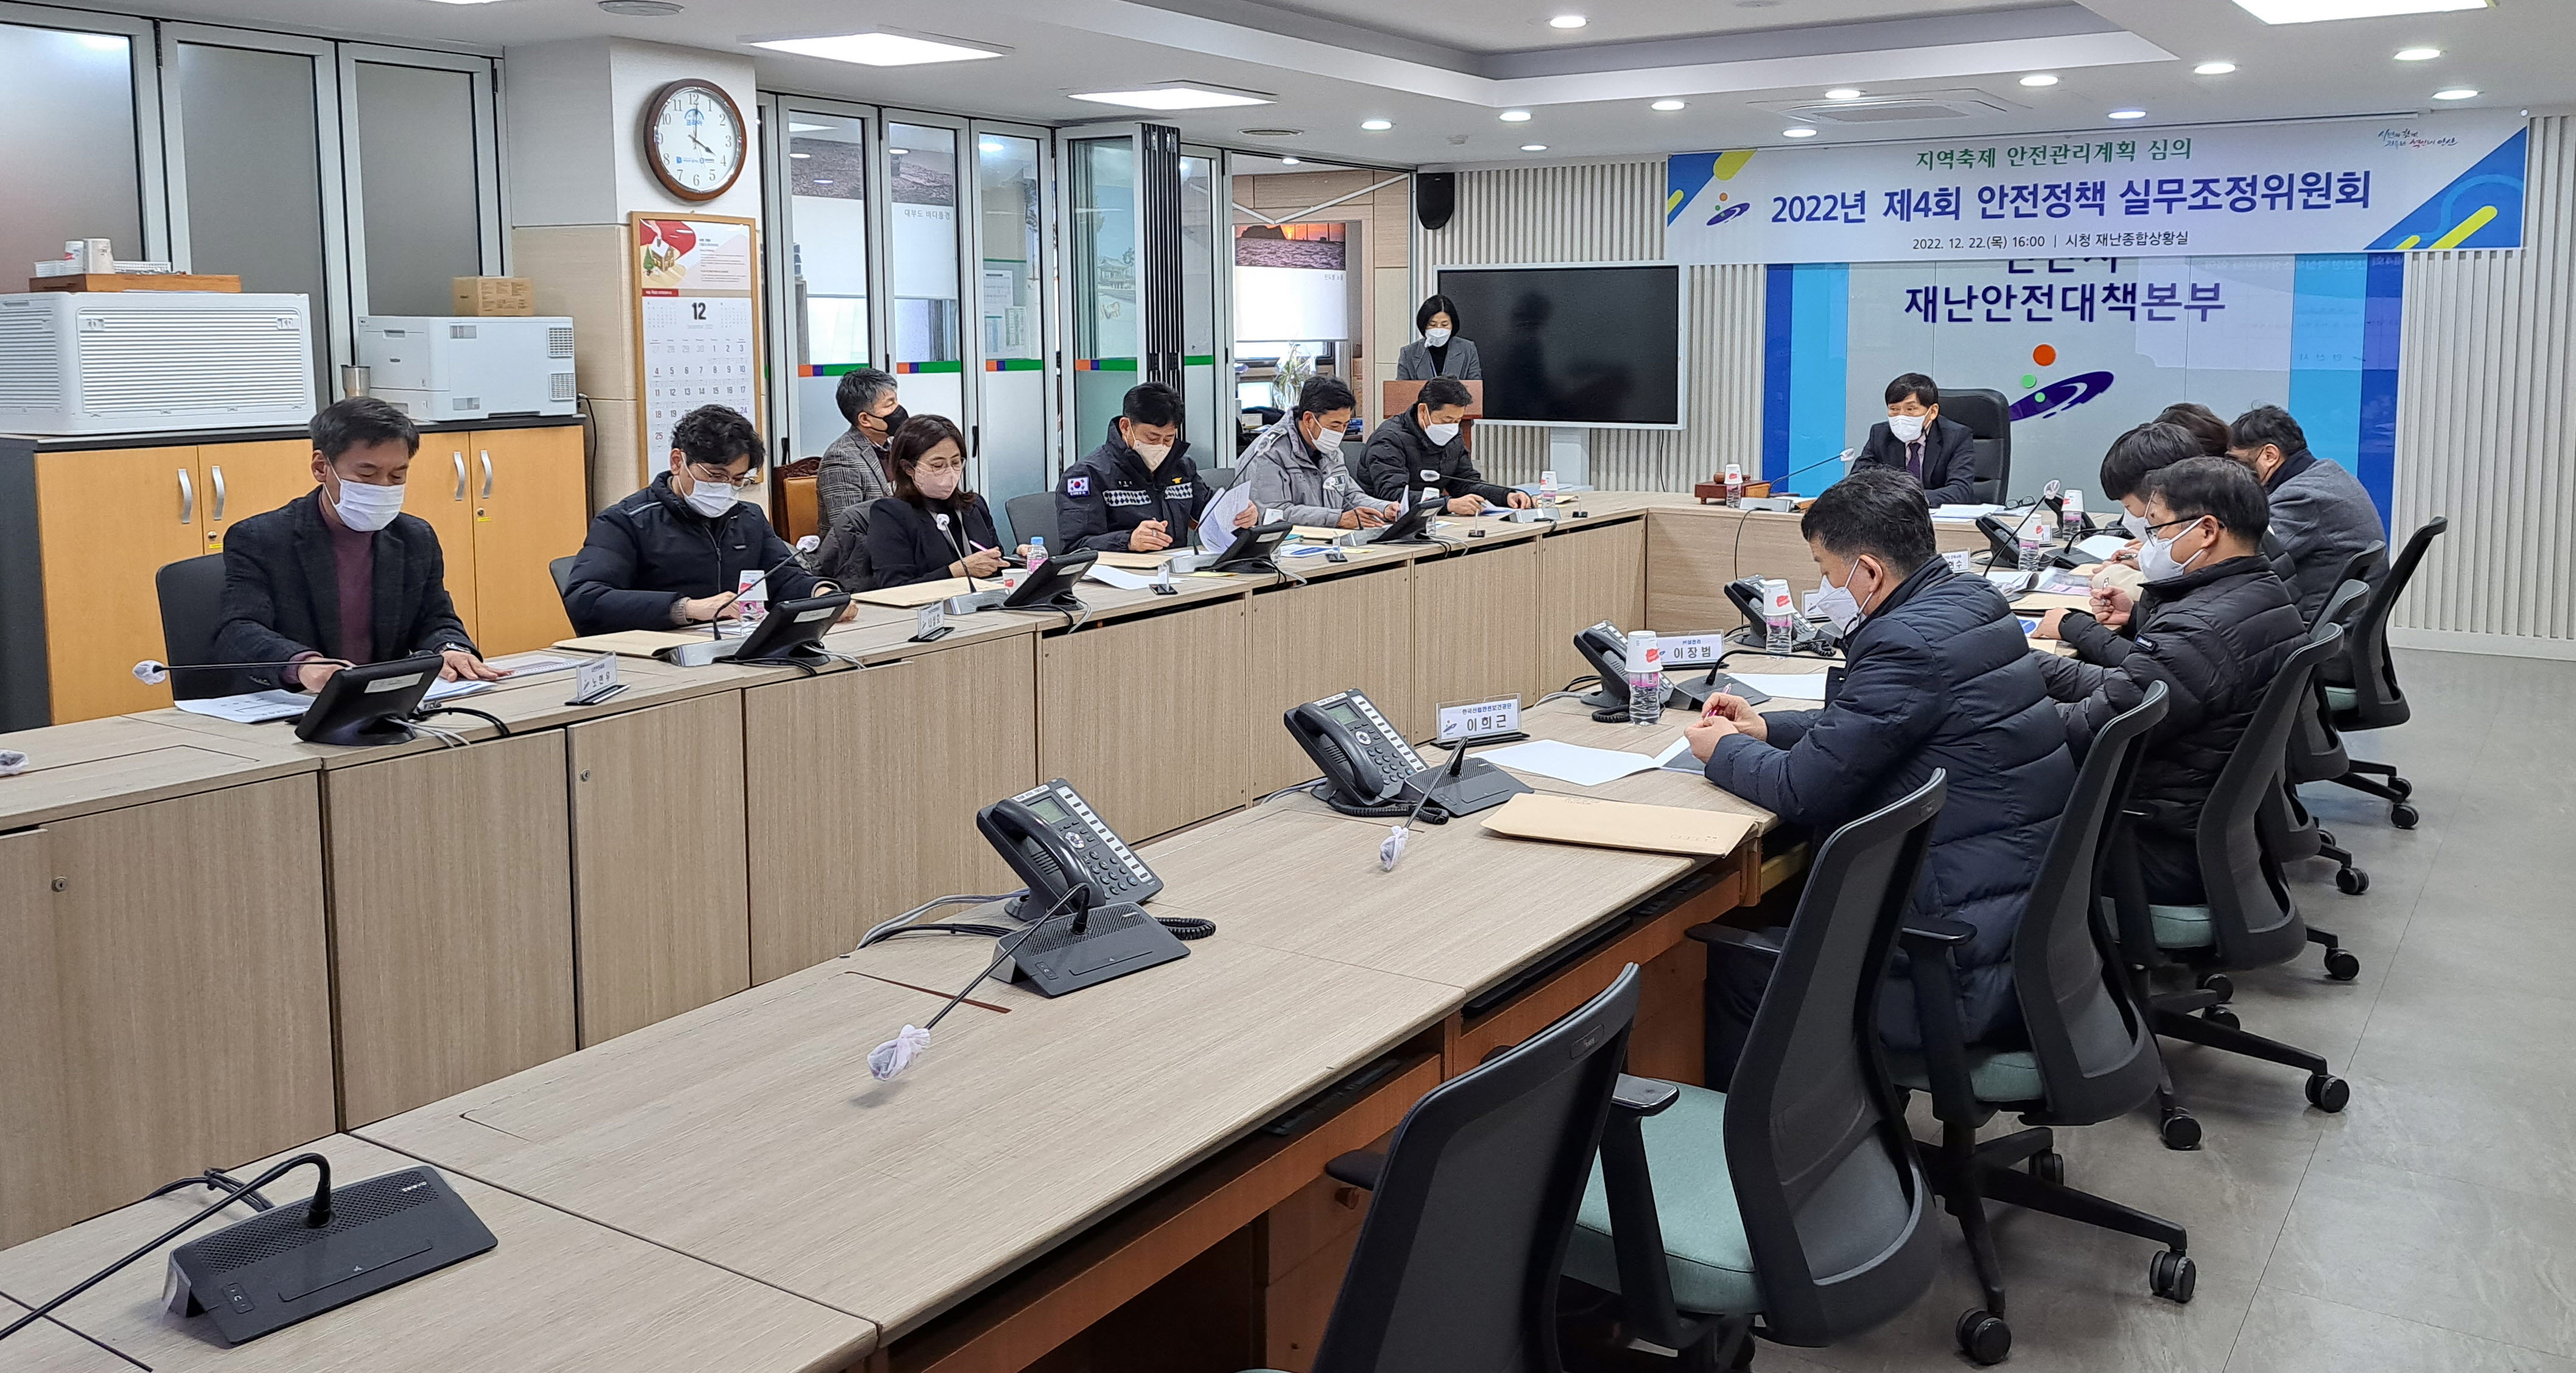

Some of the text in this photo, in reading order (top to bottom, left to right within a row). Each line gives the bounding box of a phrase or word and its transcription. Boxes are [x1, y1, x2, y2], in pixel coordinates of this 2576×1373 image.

[673, 100, 682, 111] 11
[689, 94, 699, 105] 12
[708, 99, 712, 111] 1
[662, 113, 671, 124] 10
[719, 114, 726, 126] 2
[725, 136, 732, 147] 3
[663, 153, 670, 165] 8
[1917, 138, 2191, 170] 지역축제 안전관리계획 심의
[720, 155, 726, 166] 4
[677, 169, 683, 181] 7
[693, 175, 700, 186] 6
[709, 169, 715, 181] 5
[1772, 171, 2370, 223] 2022년 제4회 안전정책 실무조정위원회
[904, 209, 950, 220] 대부도 바다풍경
[1913, 231, 2188, 249] 2022. 12. 22.(목) 16:00 시청 재난종합상황실
[1904, 283, 2225, 323] 재난안전대책본부
[692, 303, 706, 320] 12
[1674, 646, 1711, 659] 이장범
[1467, 714, 1506, 731] 이희근
